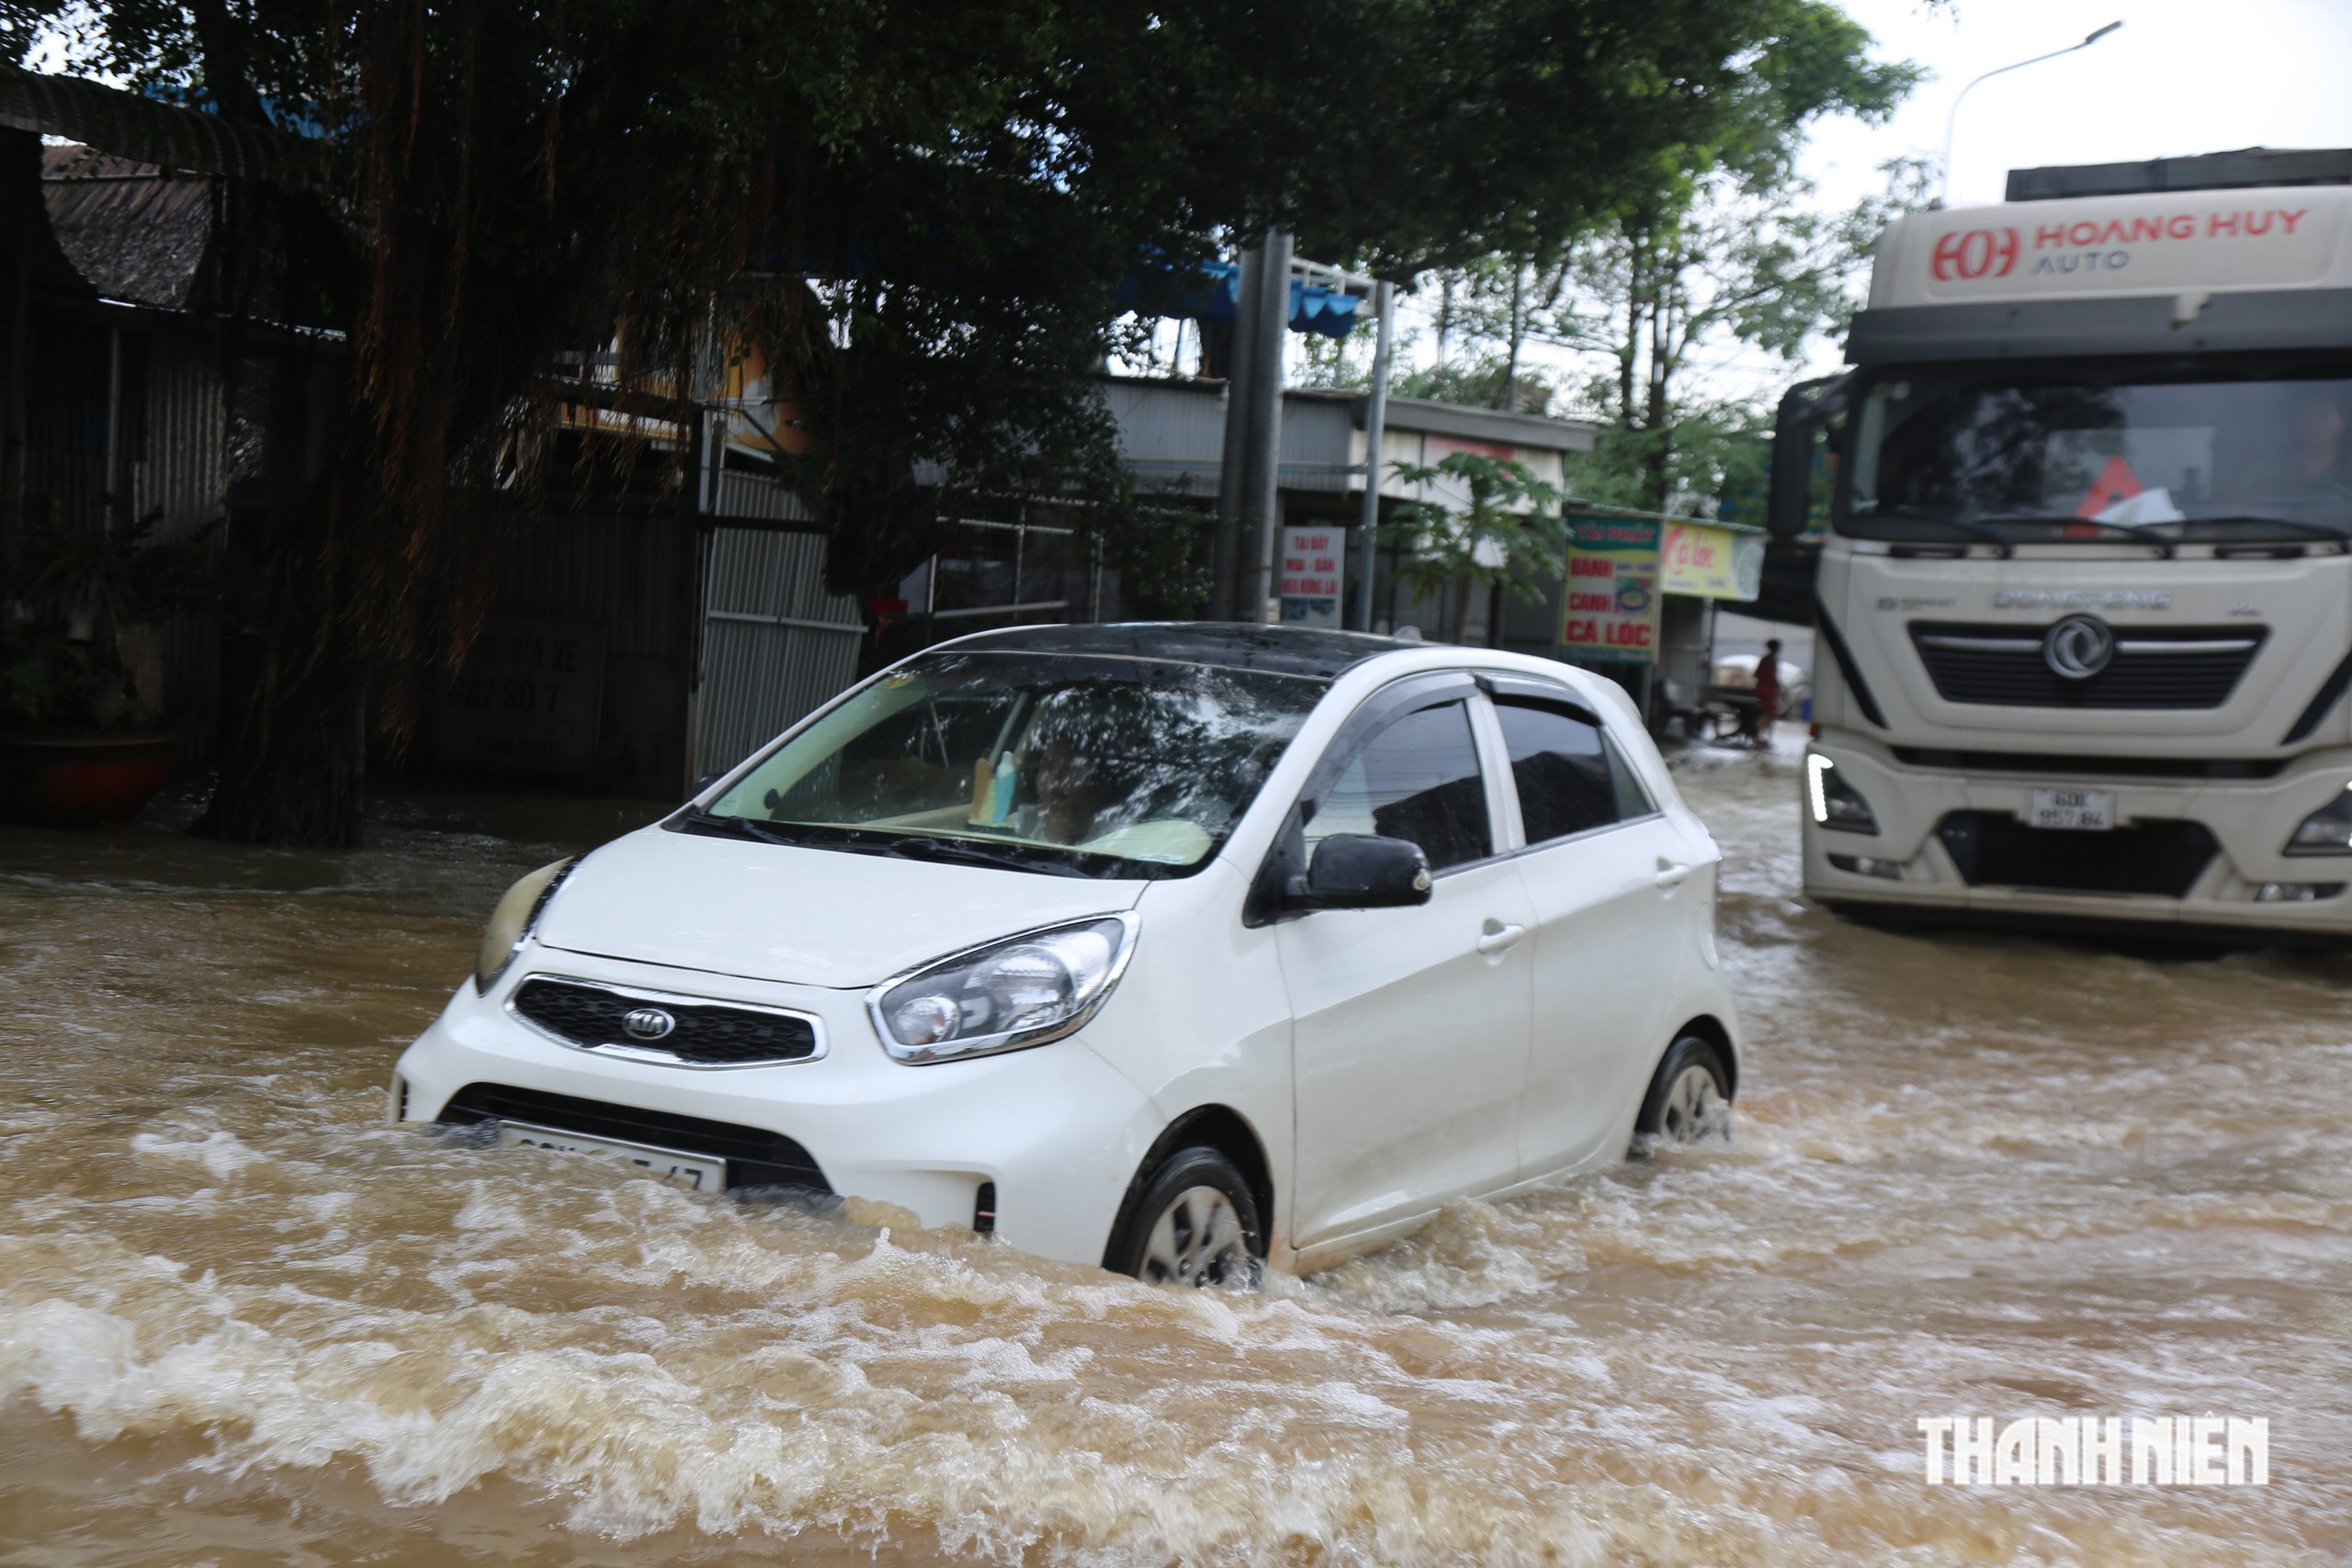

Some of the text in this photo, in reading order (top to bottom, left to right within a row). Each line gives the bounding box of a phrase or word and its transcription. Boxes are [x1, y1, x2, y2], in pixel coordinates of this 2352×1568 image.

[2033, 209, 2310, 251] HOANG HUY
[2032, 250, 2130, 275] AUTO
[1570, 556, 1613, 578] BÁNH
[1568, 592, 1611, 614] CANH
[1994, 590, 2171, 610] DONGFENG
[1566, 616, 1652, 647] CÁ LÓC
[544, 682, 560, 714] 7
[627, 1012, 664, 1034] KIA
